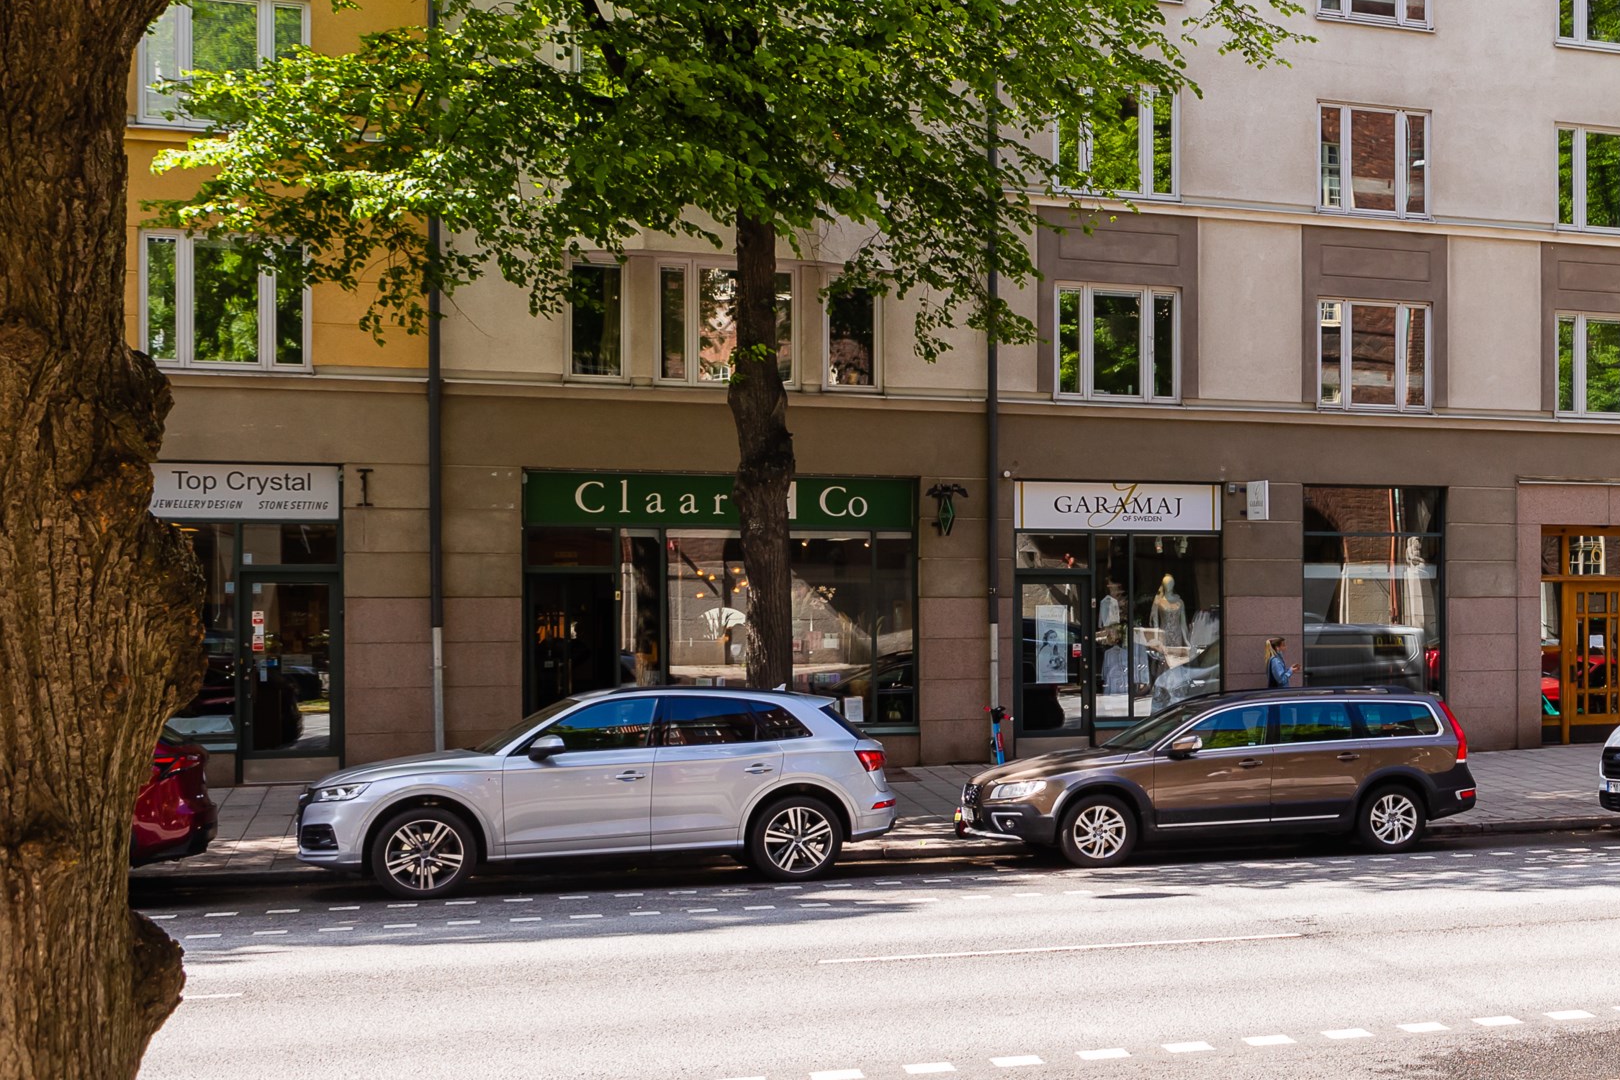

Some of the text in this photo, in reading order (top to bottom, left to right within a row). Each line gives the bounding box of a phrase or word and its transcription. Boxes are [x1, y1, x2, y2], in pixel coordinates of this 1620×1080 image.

[172, 471, 311, 495] Top Crystal
[153, 499, 243, 509] JEWELLERY DESIGN
[259, 501, 329, 510] STONE SETTING
[818, 486, 868, 517] Co
[1054, 496, 1183, 518] GARAMAJ
